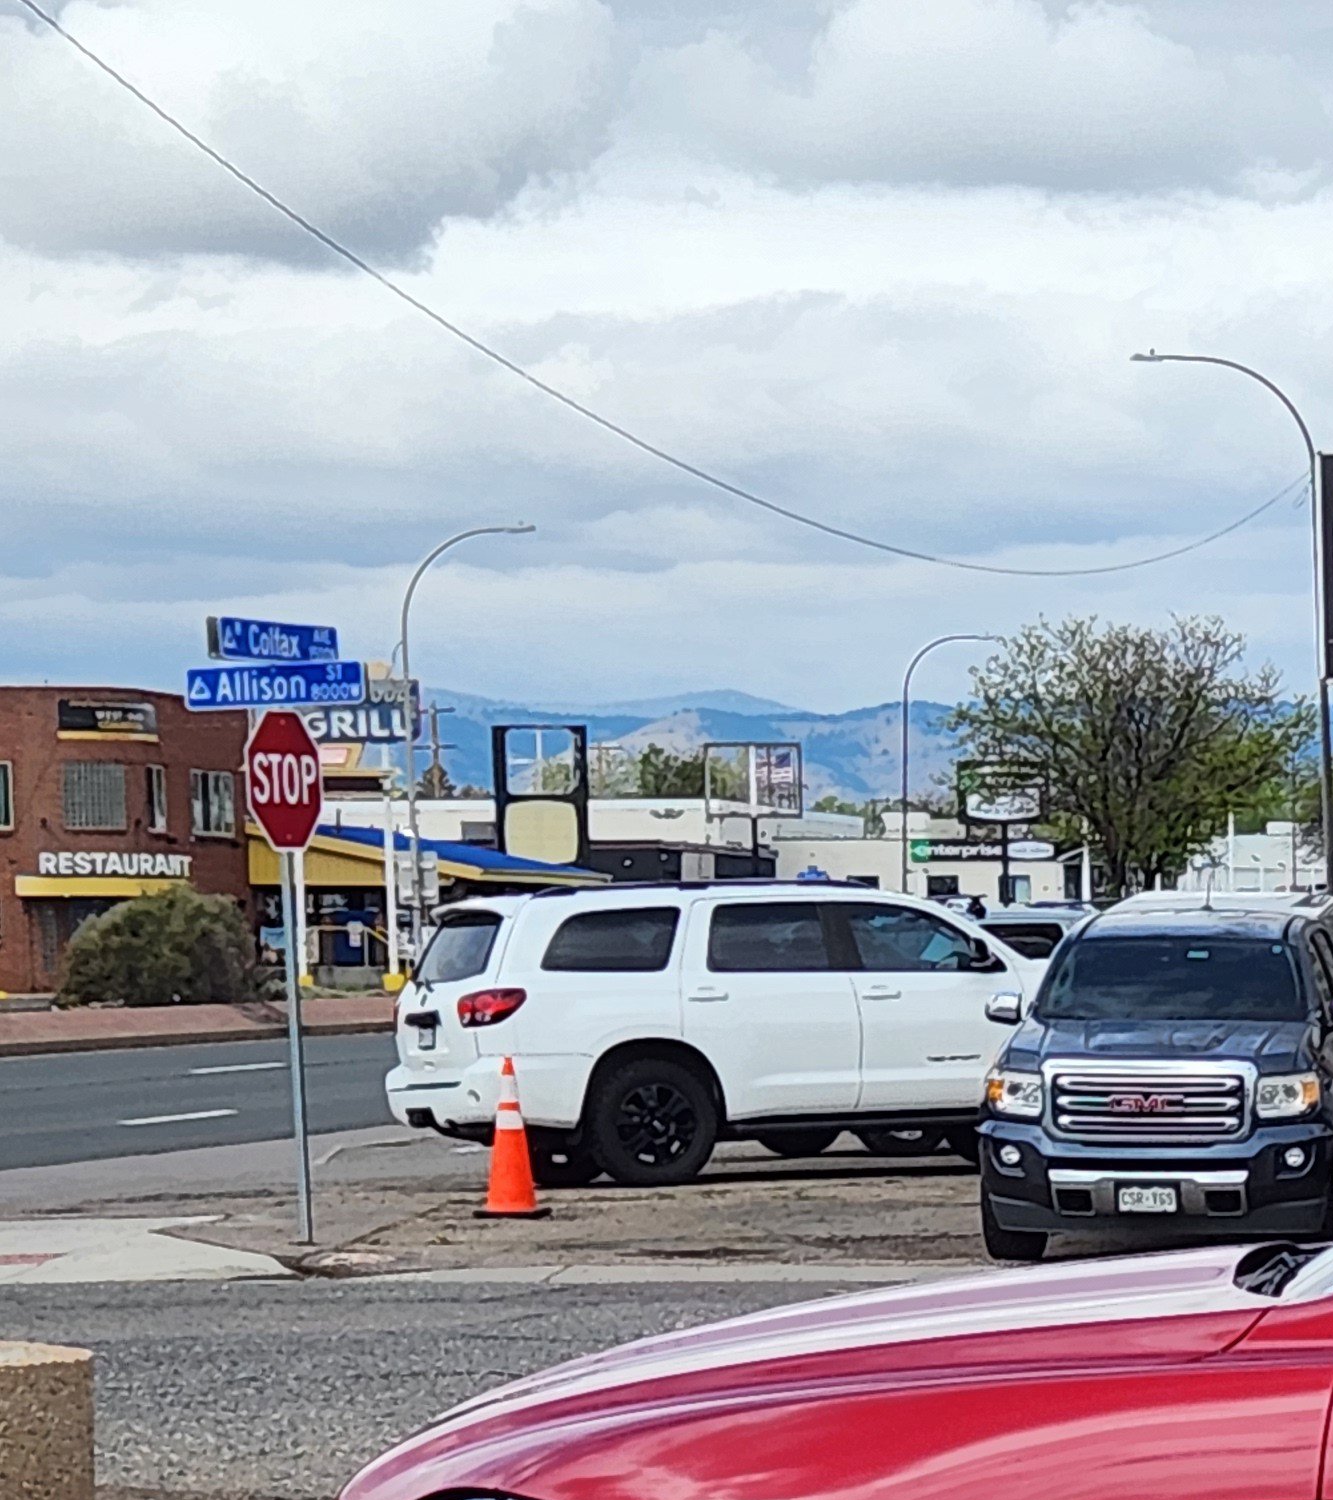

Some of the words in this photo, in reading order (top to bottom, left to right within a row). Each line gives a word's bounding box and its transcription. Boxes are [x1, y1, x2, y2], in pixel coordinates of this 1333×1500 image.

[216, 670, 306, 702] Allison
[325, 664, 342, 681] ST
[302, 709, 407, 738] GRILL
[253, 752, 316, 805] STOP
[38, 852, 192, 877] RESTAURANT
